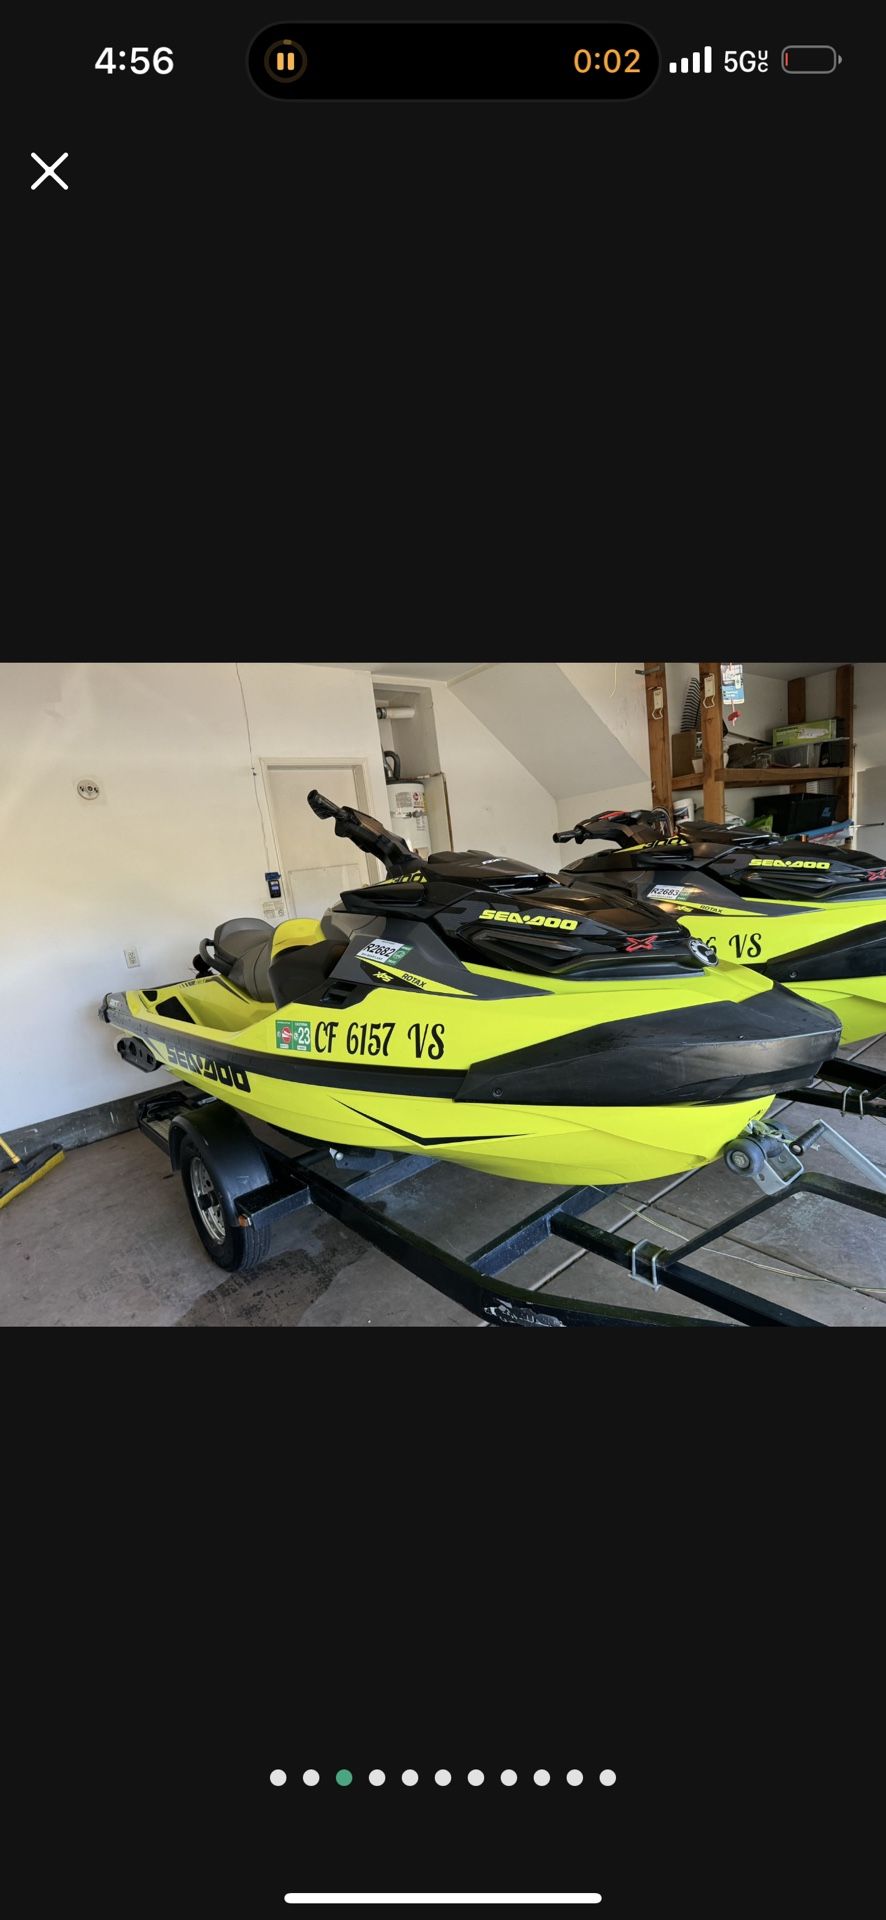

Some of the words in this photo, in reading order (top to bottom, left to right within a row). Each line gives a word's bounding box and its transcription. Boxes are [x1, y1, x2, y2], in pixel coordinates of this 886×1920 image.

[651, 888, 679, 896] R2683
[364, 943, 396, 957] R2682
[728, 932, 761, 959] VS
[401, 973, 426, 987] ROTAX
[298, 1027, 311, 1045] 23
[314, 1021, 339, 1053] CF
[346, 1022, 396, 1056] 6157
[407, 1023, 445, 1060] VS
